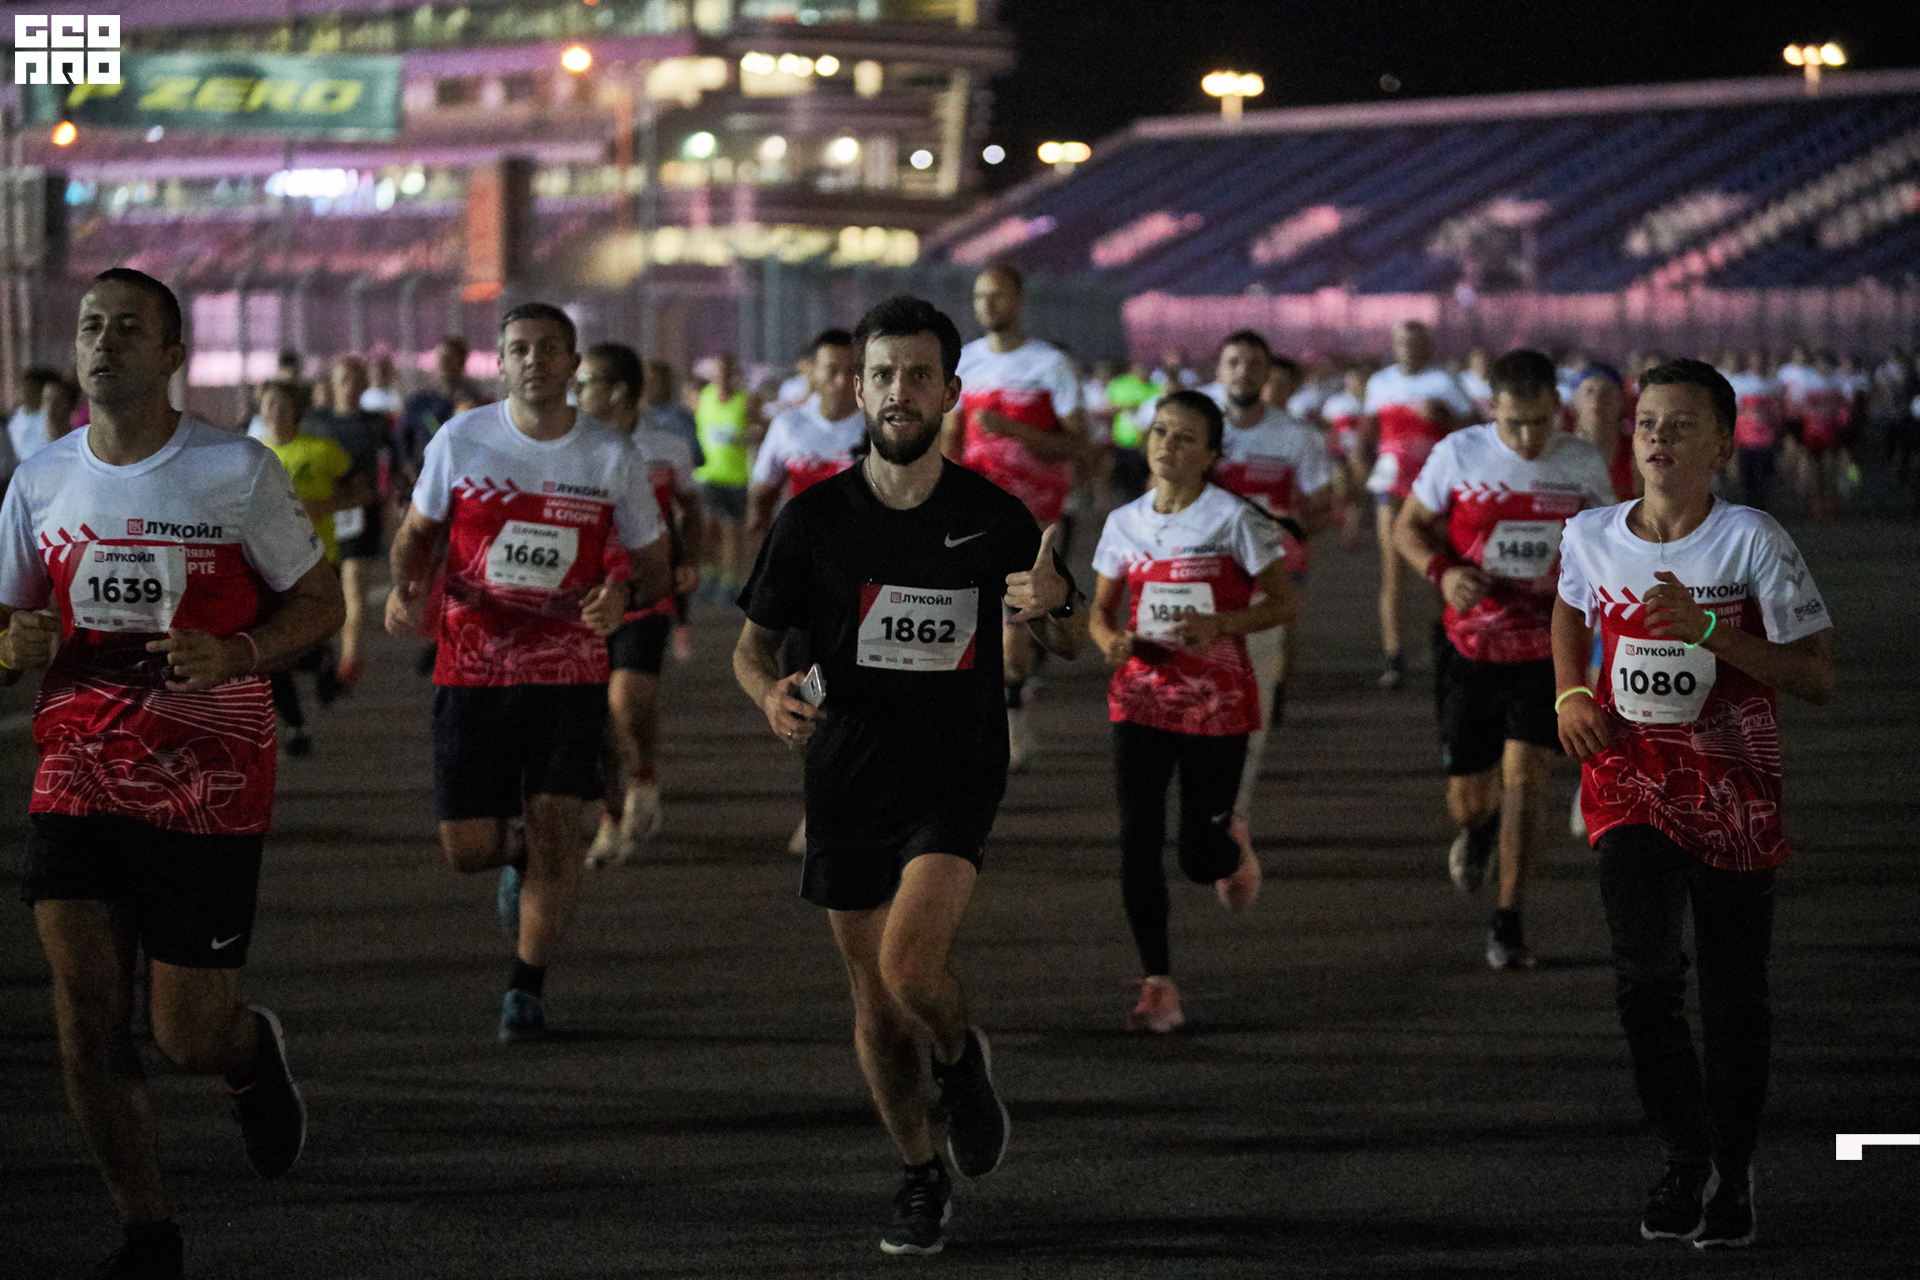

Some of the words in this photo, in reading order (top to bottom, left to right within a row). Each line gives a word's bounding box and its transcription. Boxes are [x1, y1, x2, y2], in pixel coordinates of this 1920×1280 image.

[139, 77, 362, 113] ZERO
[145, 521, 222, 538] ЛУКОЙЛ
[105, 551, 155, 563] ЛУКОЙЛ
[504, 543, 559, 568] 1662
[187, 561, 216, 575] РТЕ
[88, 576, 163, 604] 1639
[902, 594, 952, 605] ЛУКОЙЛ
[881, 616, 956, 644] 1862
[1636, 646, 1685, 657] ЛУКОЙЛ
[1620, 667, 1696, 696] 1080
